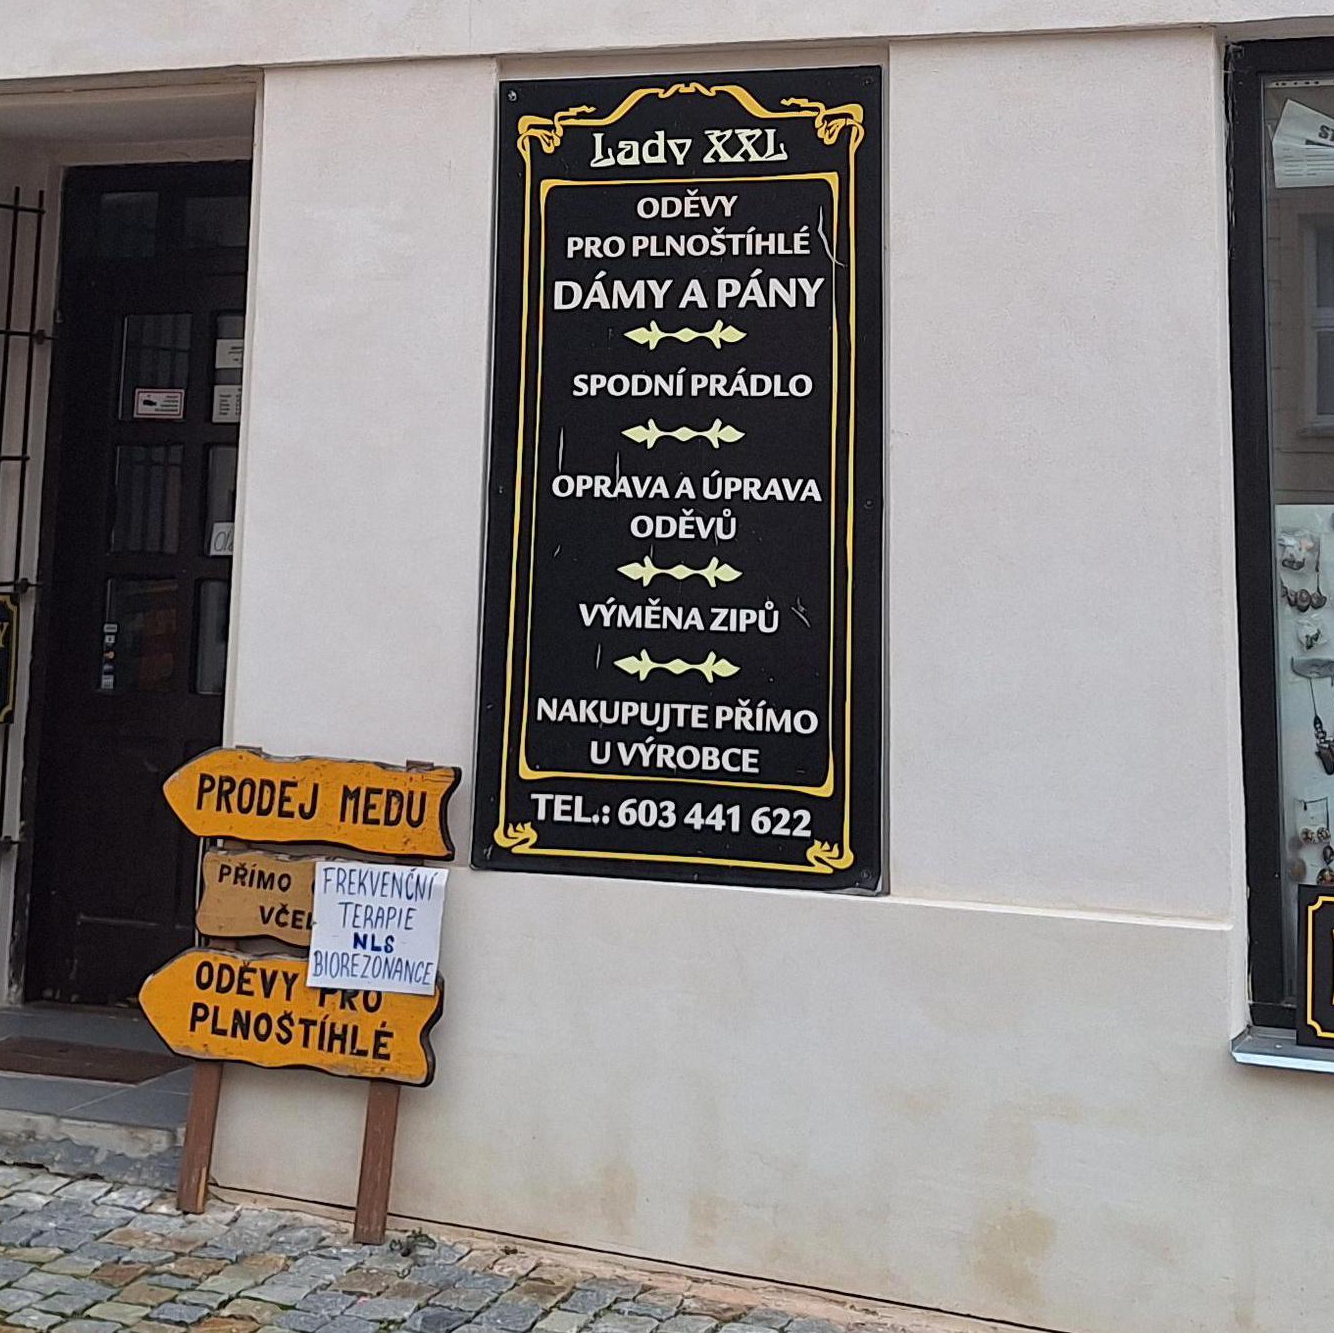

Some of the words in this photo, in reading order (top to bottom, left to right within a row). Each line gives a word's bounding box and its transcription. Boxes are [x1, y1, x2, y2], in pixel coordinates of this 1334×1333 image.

[703, 128, 788, 164] XXL
[636, 188, 738, 218] ODĚVY
[566, 237, 625, 259] PRO
[632, 226, 810, 257] PLNOŠTÍHLÉ
[553, 271, 673, 310] DÁMY
[678, 279, 708, 309] A
[717, 268, 825, 309] PÁNY
[572, 368, 685, 397] SPODNÍ
[691, 368, 813, 398] PRÁDLO
[551, 475, 669, 499] OPRAVA
[674, 477, 696, 500] A
[702, 470, 822, 502] ÚPRAVA
[630, 508, 737, 540] ODĚVŮ
[579, 598, 704, 630] VÝMĚNA
[710, 601, 779, 633] ZIPŮ
[537, 698, 708, 732] NAKUPUJTE
[715, 698, 818, 734] PŘÍMO
[590, 741, 611, 764] U
[617, 737, 760, 774] VÝROBCE
[196, 773, 319, 820] PRODEJ
[339, 785, 427, 828] MEDU
[531, 794, 611, 824] TEL.:
[618, 799, 676, 827] 603
[684, 805, 741, 832] 441
[751, 807, 812, 837] 622
[218, 863, 292, 892] PŘÍMO
[322, 866, 438, 902] FREKVENČNÍ
[339, 901, 417, 930] TERAPIE
[353, 932, 395, 954] NLS
[312, 950, 434, 986] BIOREZONANCE
[195, 961, 299, 1001] ODĚVY
[317, 988, 383, 1013] PRO
[189, 1001, 394, 1061] PLNOŠTÍHLÉ
